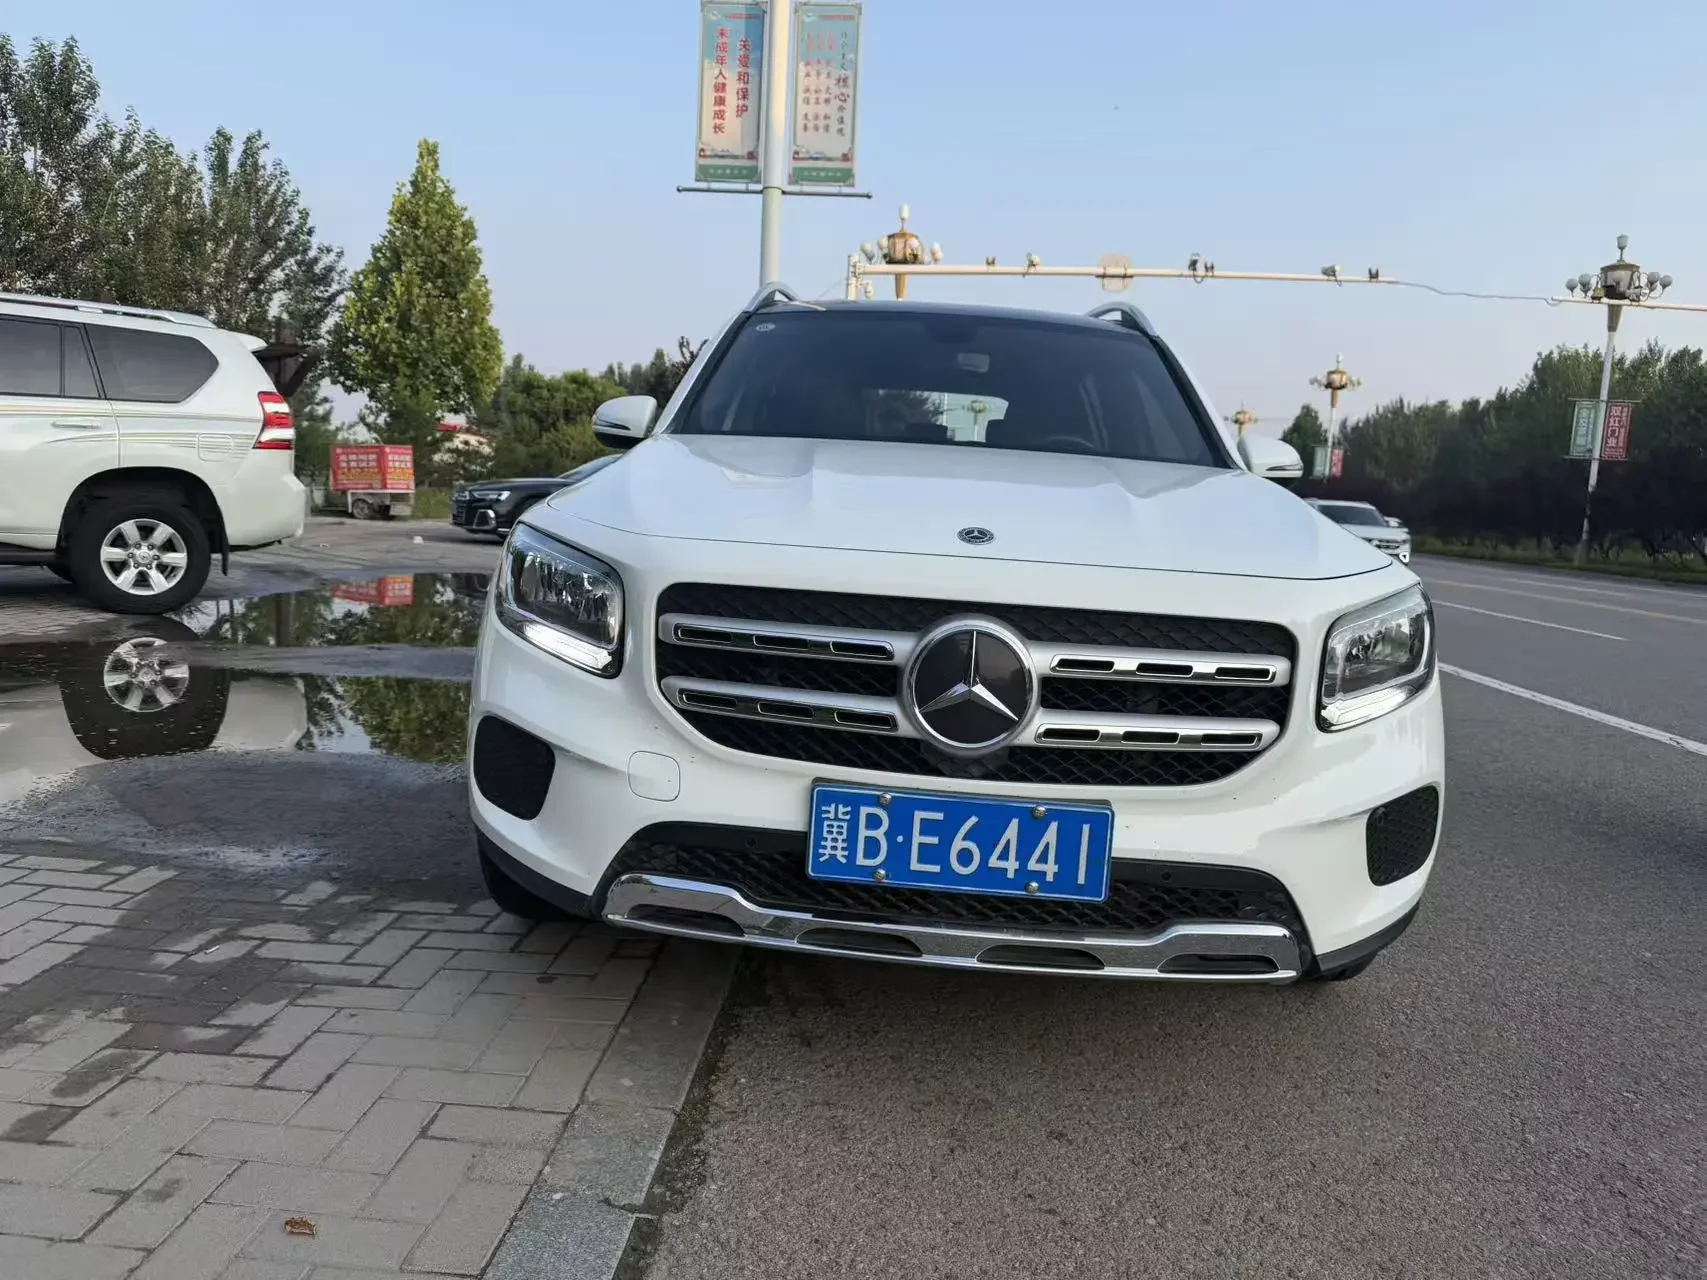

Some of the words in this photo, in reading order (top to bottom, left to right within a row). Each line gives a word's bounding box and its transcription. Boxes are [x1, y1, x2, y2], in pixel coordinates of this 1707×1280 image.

[712, 28, 729, 134] 未成年人健康成长
[736, 37, 751, 118] 关爱和保护
[818, 803, 1090, 885] 冀B·E6441
